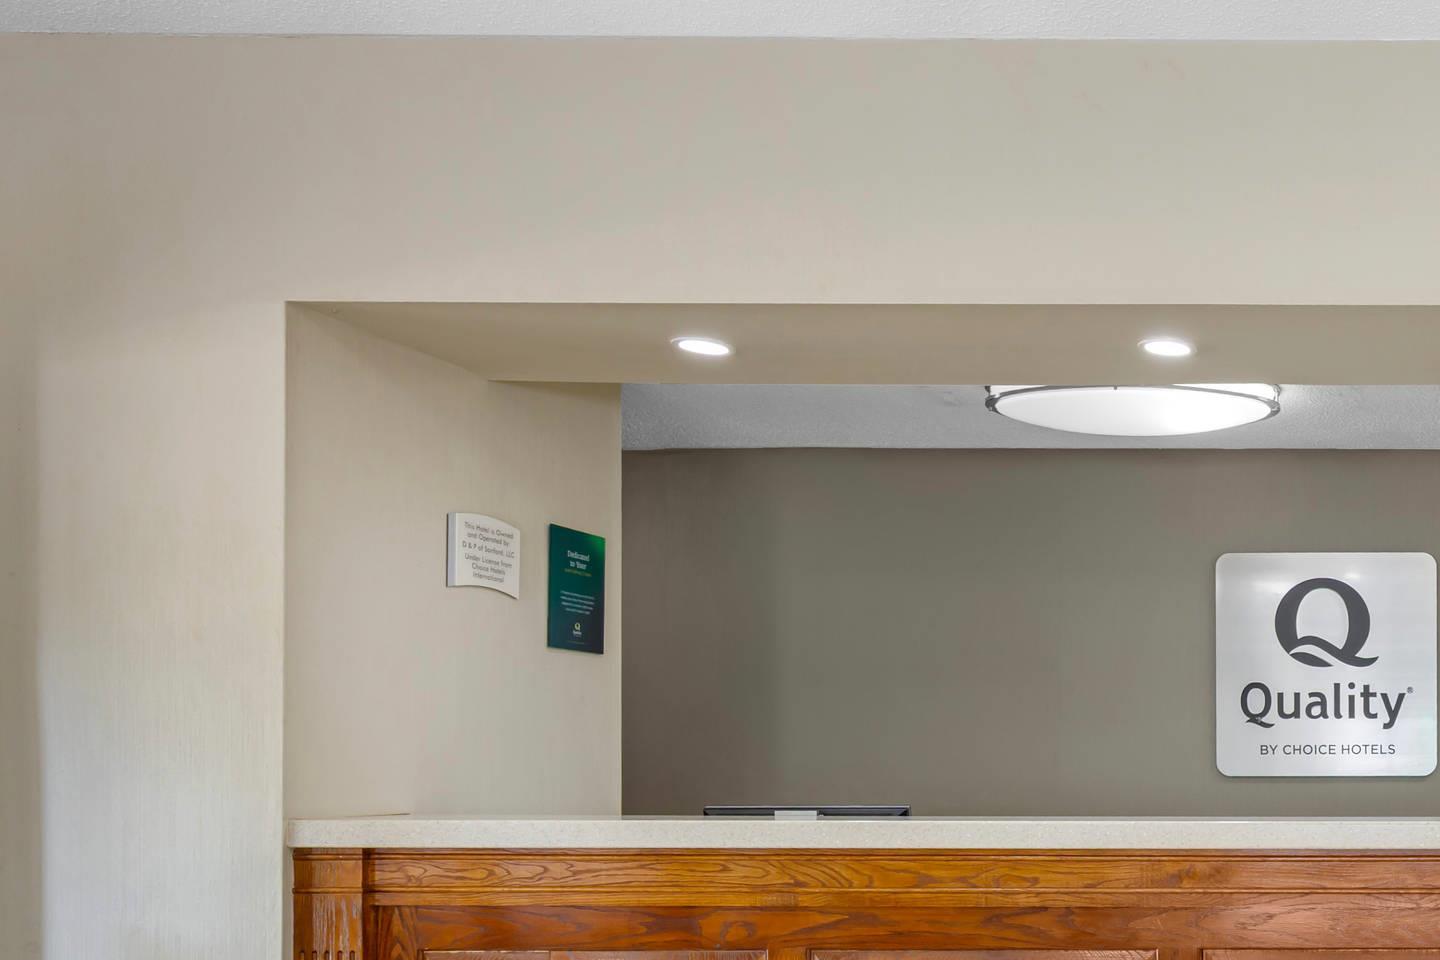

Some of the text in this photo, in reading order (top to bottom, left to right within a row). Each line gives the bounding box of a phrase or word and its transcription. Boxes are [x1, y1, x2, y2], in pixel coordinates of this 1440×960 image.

[479, 533, 502, 545] Operated
[495, 529, 514, 539] Owned
[464, 552, 481, 562] Under
[482, 555, 500, 566] License
[506, 549, 515, 559] LLC
[471, 562, 489, 572] Choice
[1240, 681, 1406, 730] Quality
[1259, 744, 1397, 755] BY CHOICE HOTELS
